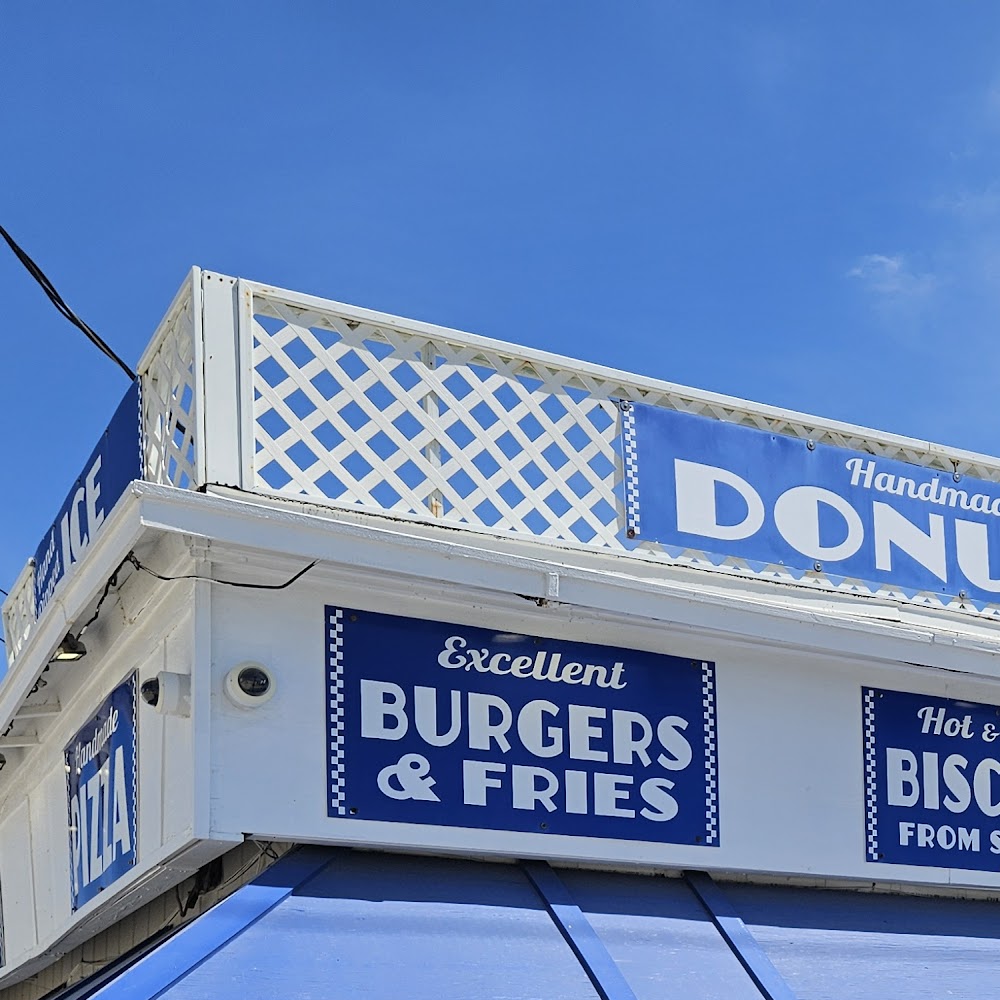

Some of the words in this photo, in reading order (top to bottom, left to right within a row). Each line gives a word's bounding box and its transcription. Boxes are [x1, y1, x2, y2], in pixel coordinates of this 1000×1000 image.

[61, 454, 105, 575] ICE
[437, 635, 628, 690] Excellent
[75, 706, 119, 770] Handmade
[360, 678, 693, 772] BURGERS
[917, 706, 975, 739] Hot
[981, 723, 1000, 742] &
[71, 744, 131, 897] PIZZA
[376, 752, 442, 803] &
[462, 758, 680, 823] FRIES
[898, 821, 981, 852] FROM
